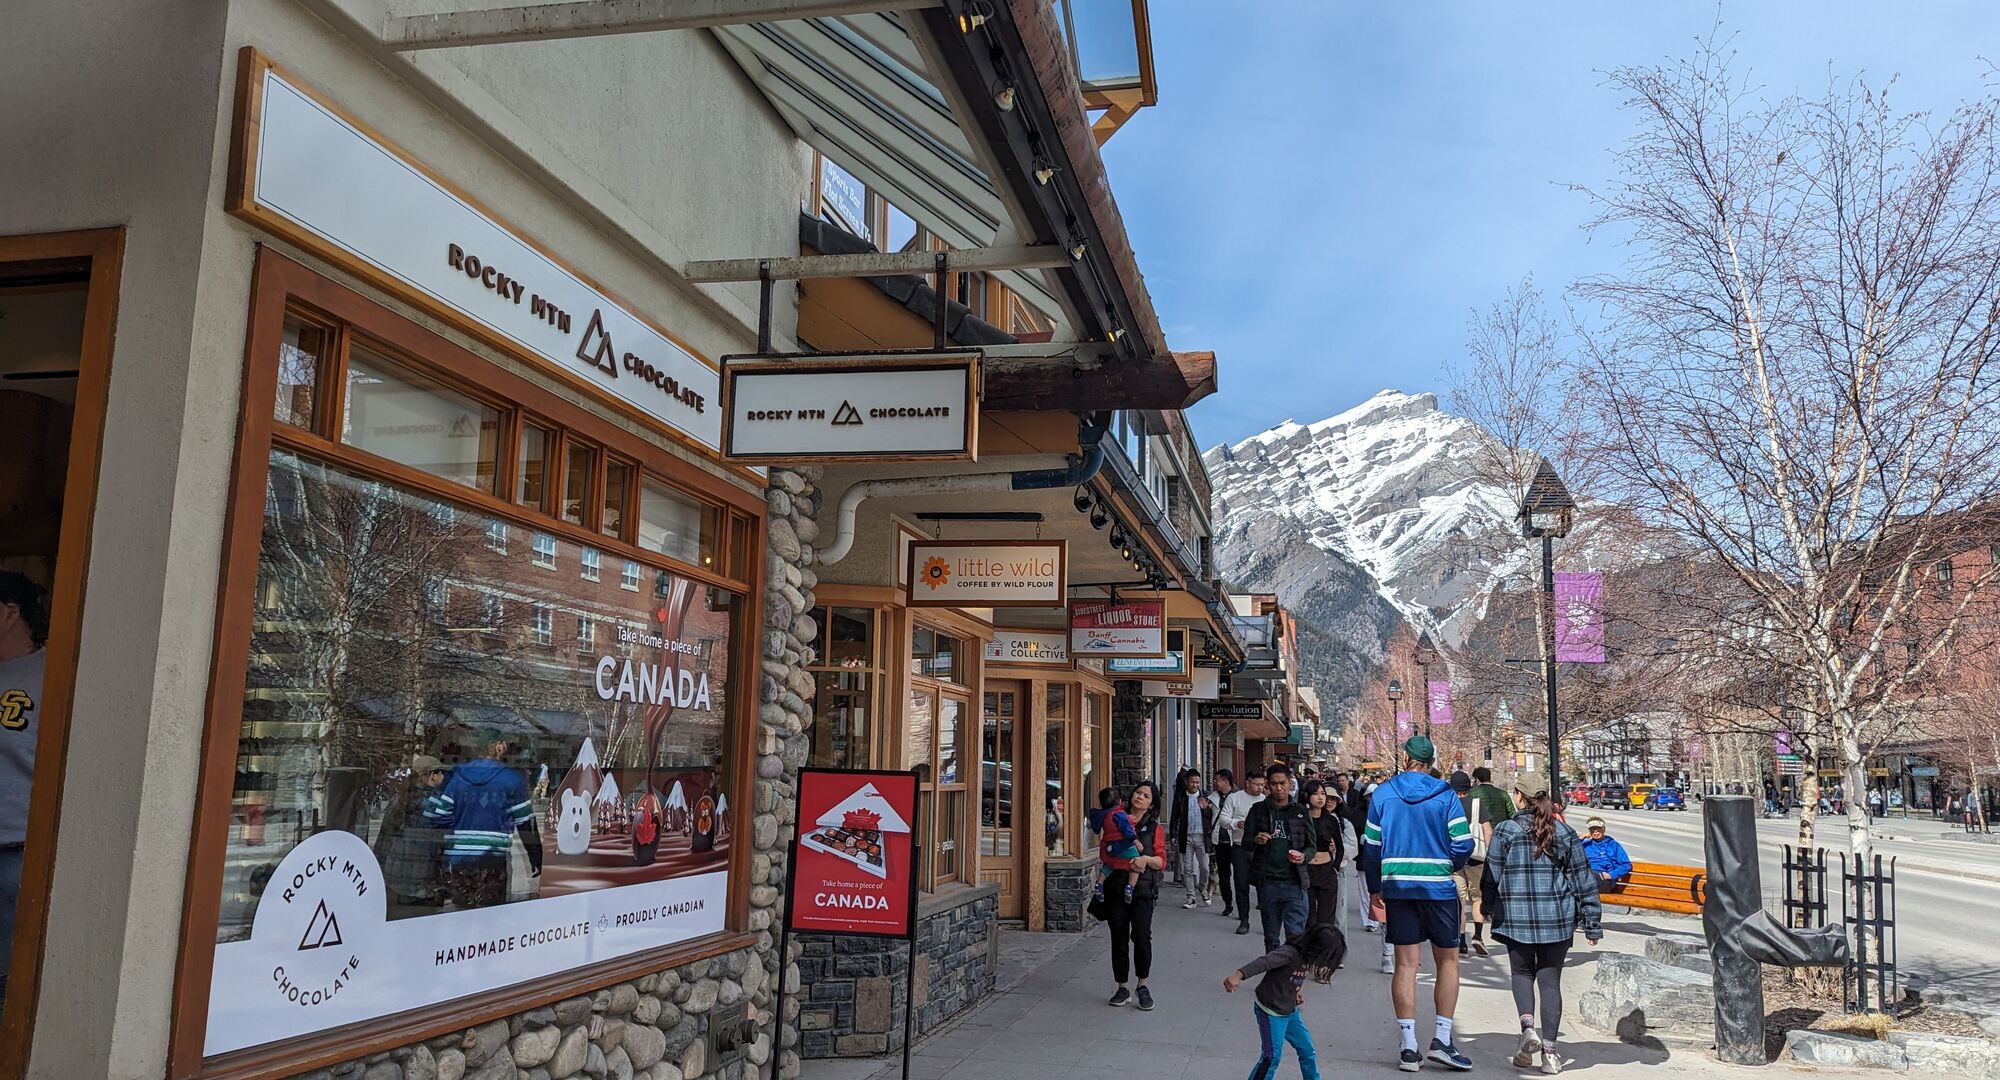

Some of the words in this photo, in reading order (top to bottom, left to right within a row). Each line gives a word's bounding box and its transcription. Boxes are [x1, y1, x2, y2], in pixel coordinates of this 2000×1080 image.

[838, 196, 860, 228] Screen
[448, 242, 525, 305] ROCKY
[531, 293, 572, 334] MTN
[623, 352, 704, 413] CHOCOLATE
[747, 409, 792, 421] ROCKY
[798, 409, 825, 420] MTN
[869, 406, 950, 418] CHOCOLATE
[958, 558, 1004, 576] little
[1010, 558, 1054, 576] wild
[1074, 604, 1105, 616] SIDESTREET
[1097, 608, 1132, 625] LIQUOR
[1133, 615, 1158, 626] STORE
[617, 625, 637, 643] Take
[639, 630, 663, 649] home
[664, 638, 671, 650] a
[671, 638, 692, 653] piece
[693, 644, 702, 656] of
[1088, 630, 1112, 639] Banff
[1010, 640, 1039, 649] CABIN
[1010, 649, 1065, 660] COLLECTIVE
[596, 656, 711, 711] CANADA
[1211, 704, 1260, 714] evoolution
[283, 855, 338, 905] ROCKY
[342, 861, 368, 897] MTN
[859, 882, 875, 890] piece
[814, 892, 889, 910] CANADA
[435, 936, 515, 966] HANDMADE
[520, 921, 590, 947] CHOCOLATE
[615, 909, 658, 927] PROUDLY
[661, 899, 705, 918] CANADIAN
[273, 955, 360, 1006] CHOCOLATE
